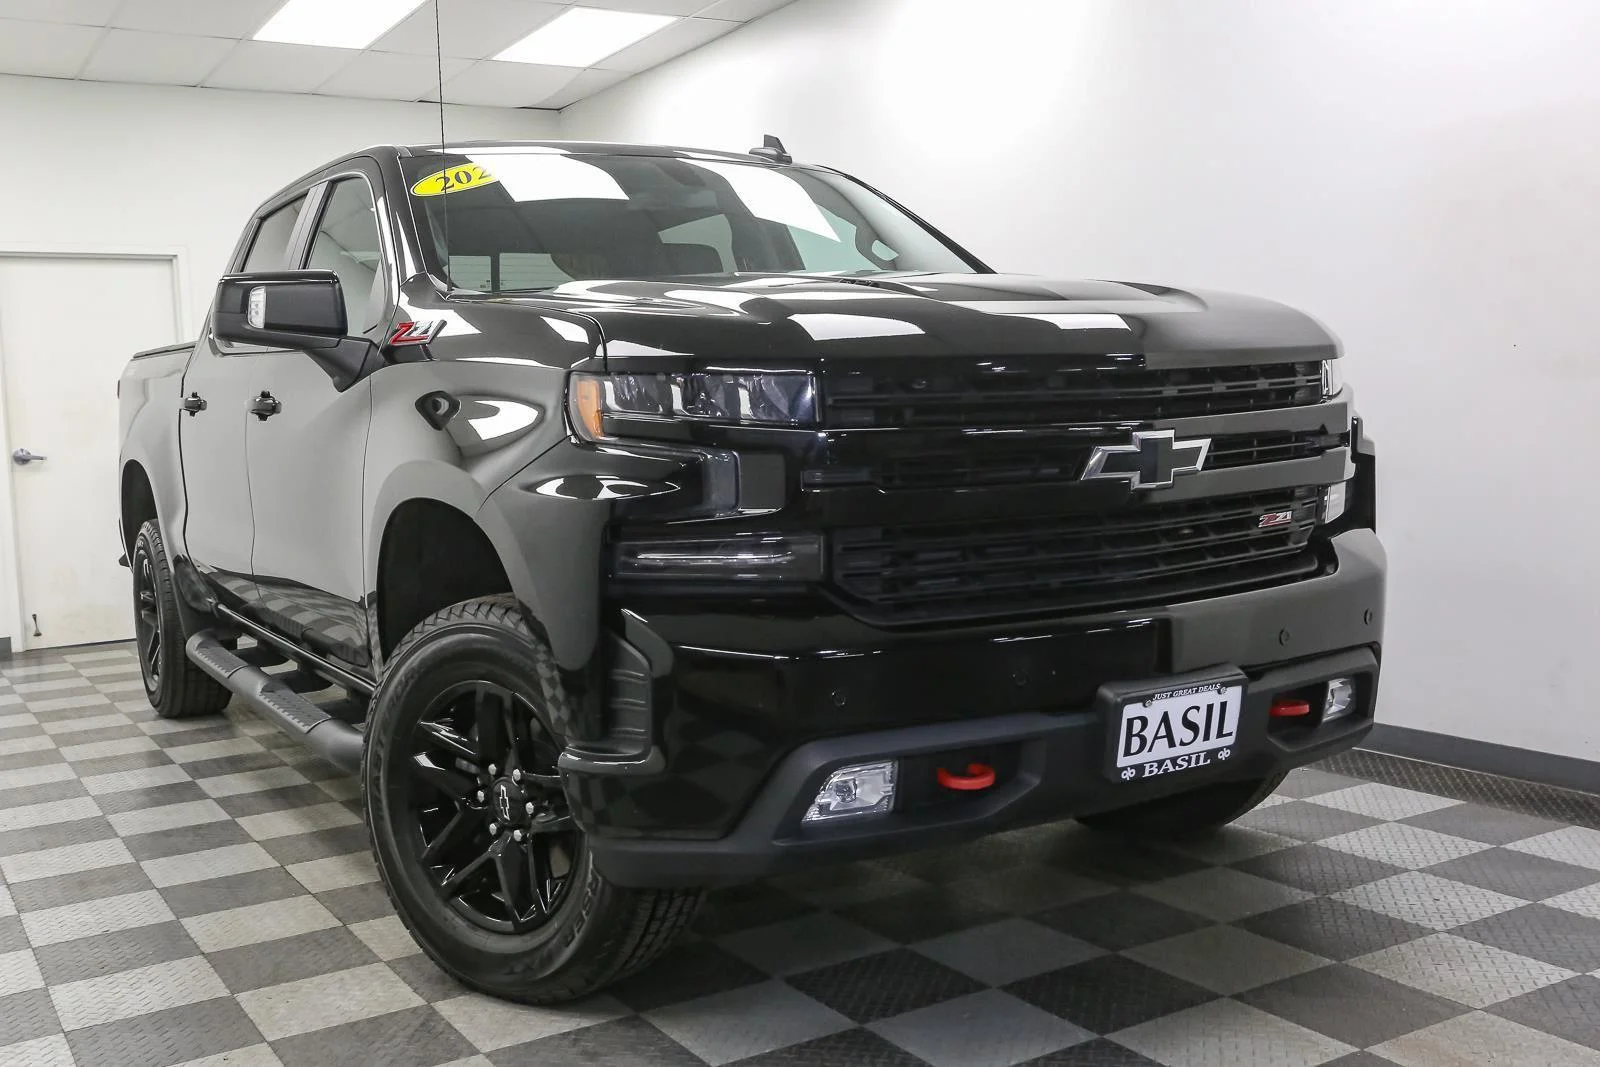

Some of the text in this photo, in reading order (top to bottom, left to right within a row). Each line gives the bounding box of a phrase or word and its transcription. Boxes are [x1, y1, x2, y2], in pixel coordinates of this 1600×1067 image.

[1258, 511, 1292, 527] Z71
[1153, 683, 1221, 700] JUST GREAT DEALS
[1122, 701, 1233, 758] BASIL
[1142, 752, 1211, 777] BASIL
